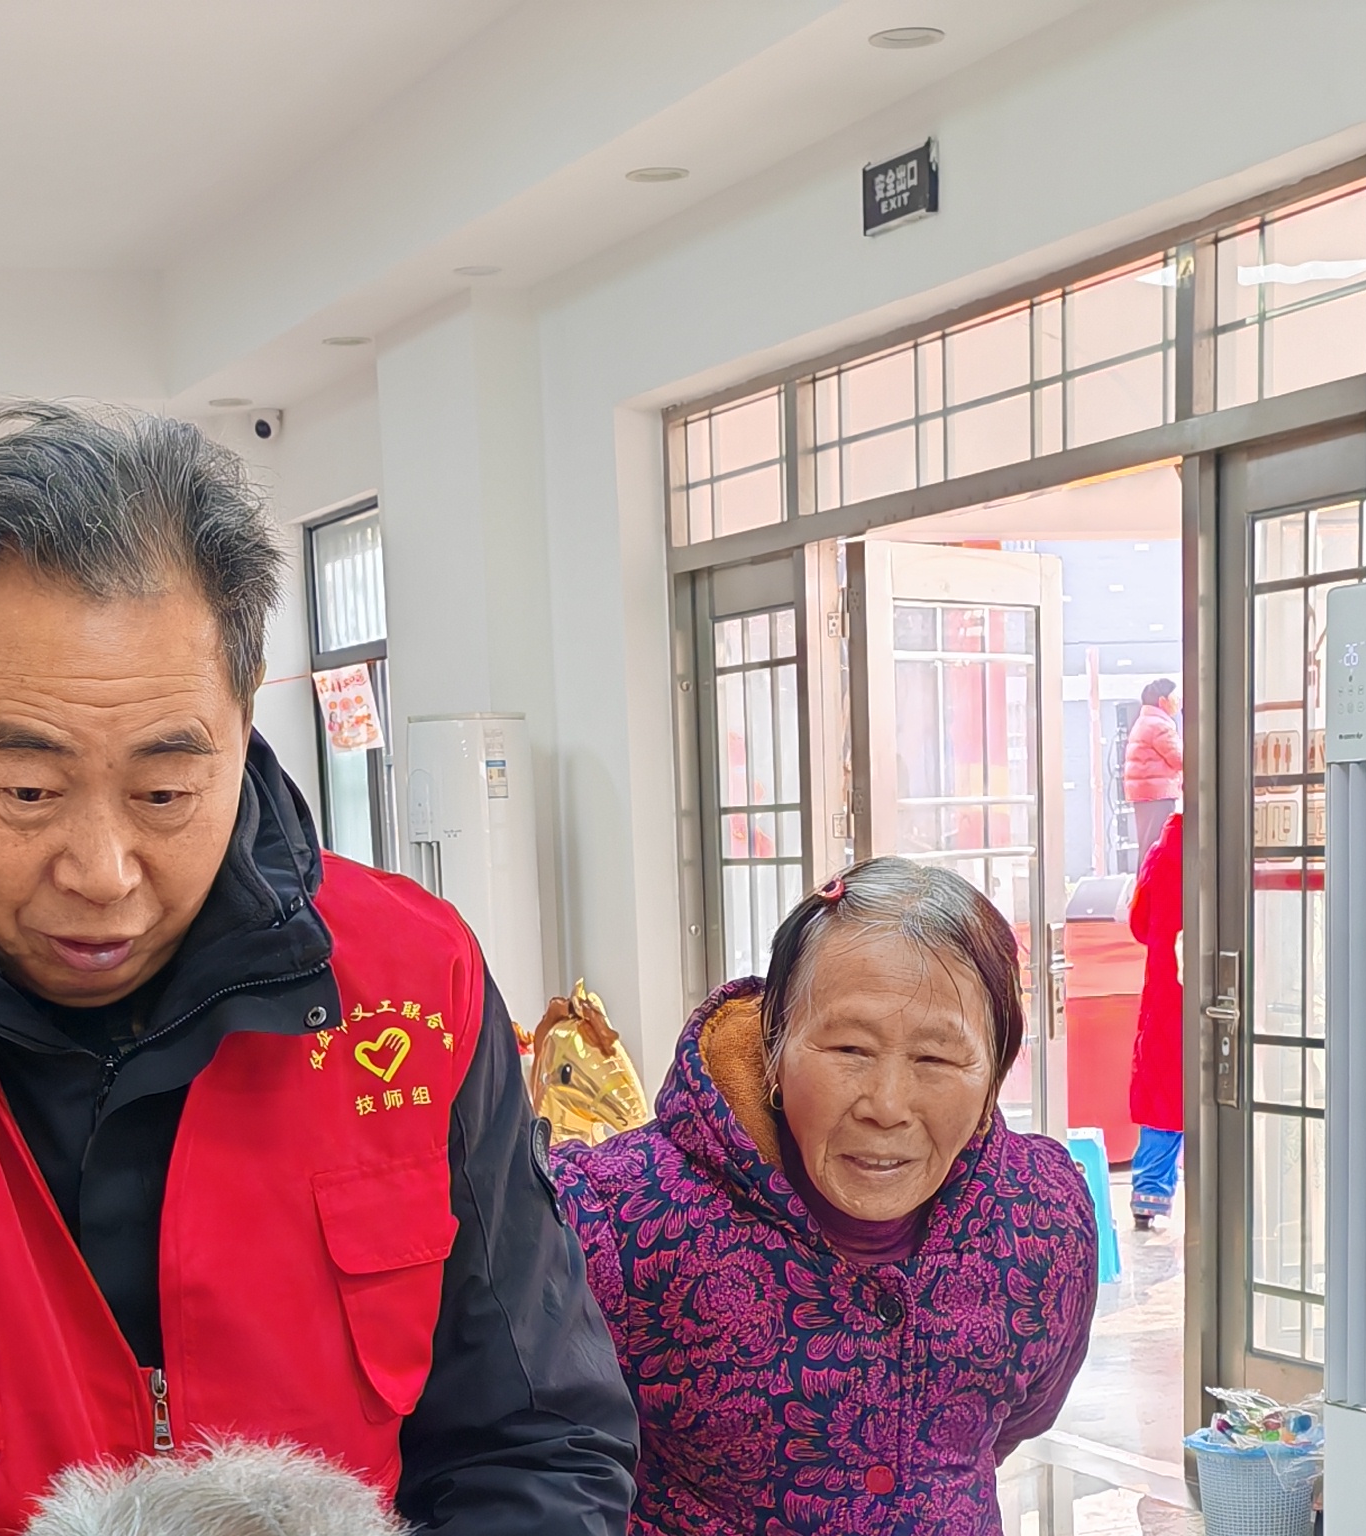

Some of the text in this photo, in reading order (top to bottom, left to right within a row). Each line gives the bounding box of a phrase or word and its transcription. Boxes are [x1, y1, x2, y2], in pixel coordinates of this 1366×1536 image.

[874, 159, 918, 202] 安全出口
[881, 192, 910, 214] EXIT
[355, 1086, 432, 1116] 技师组
